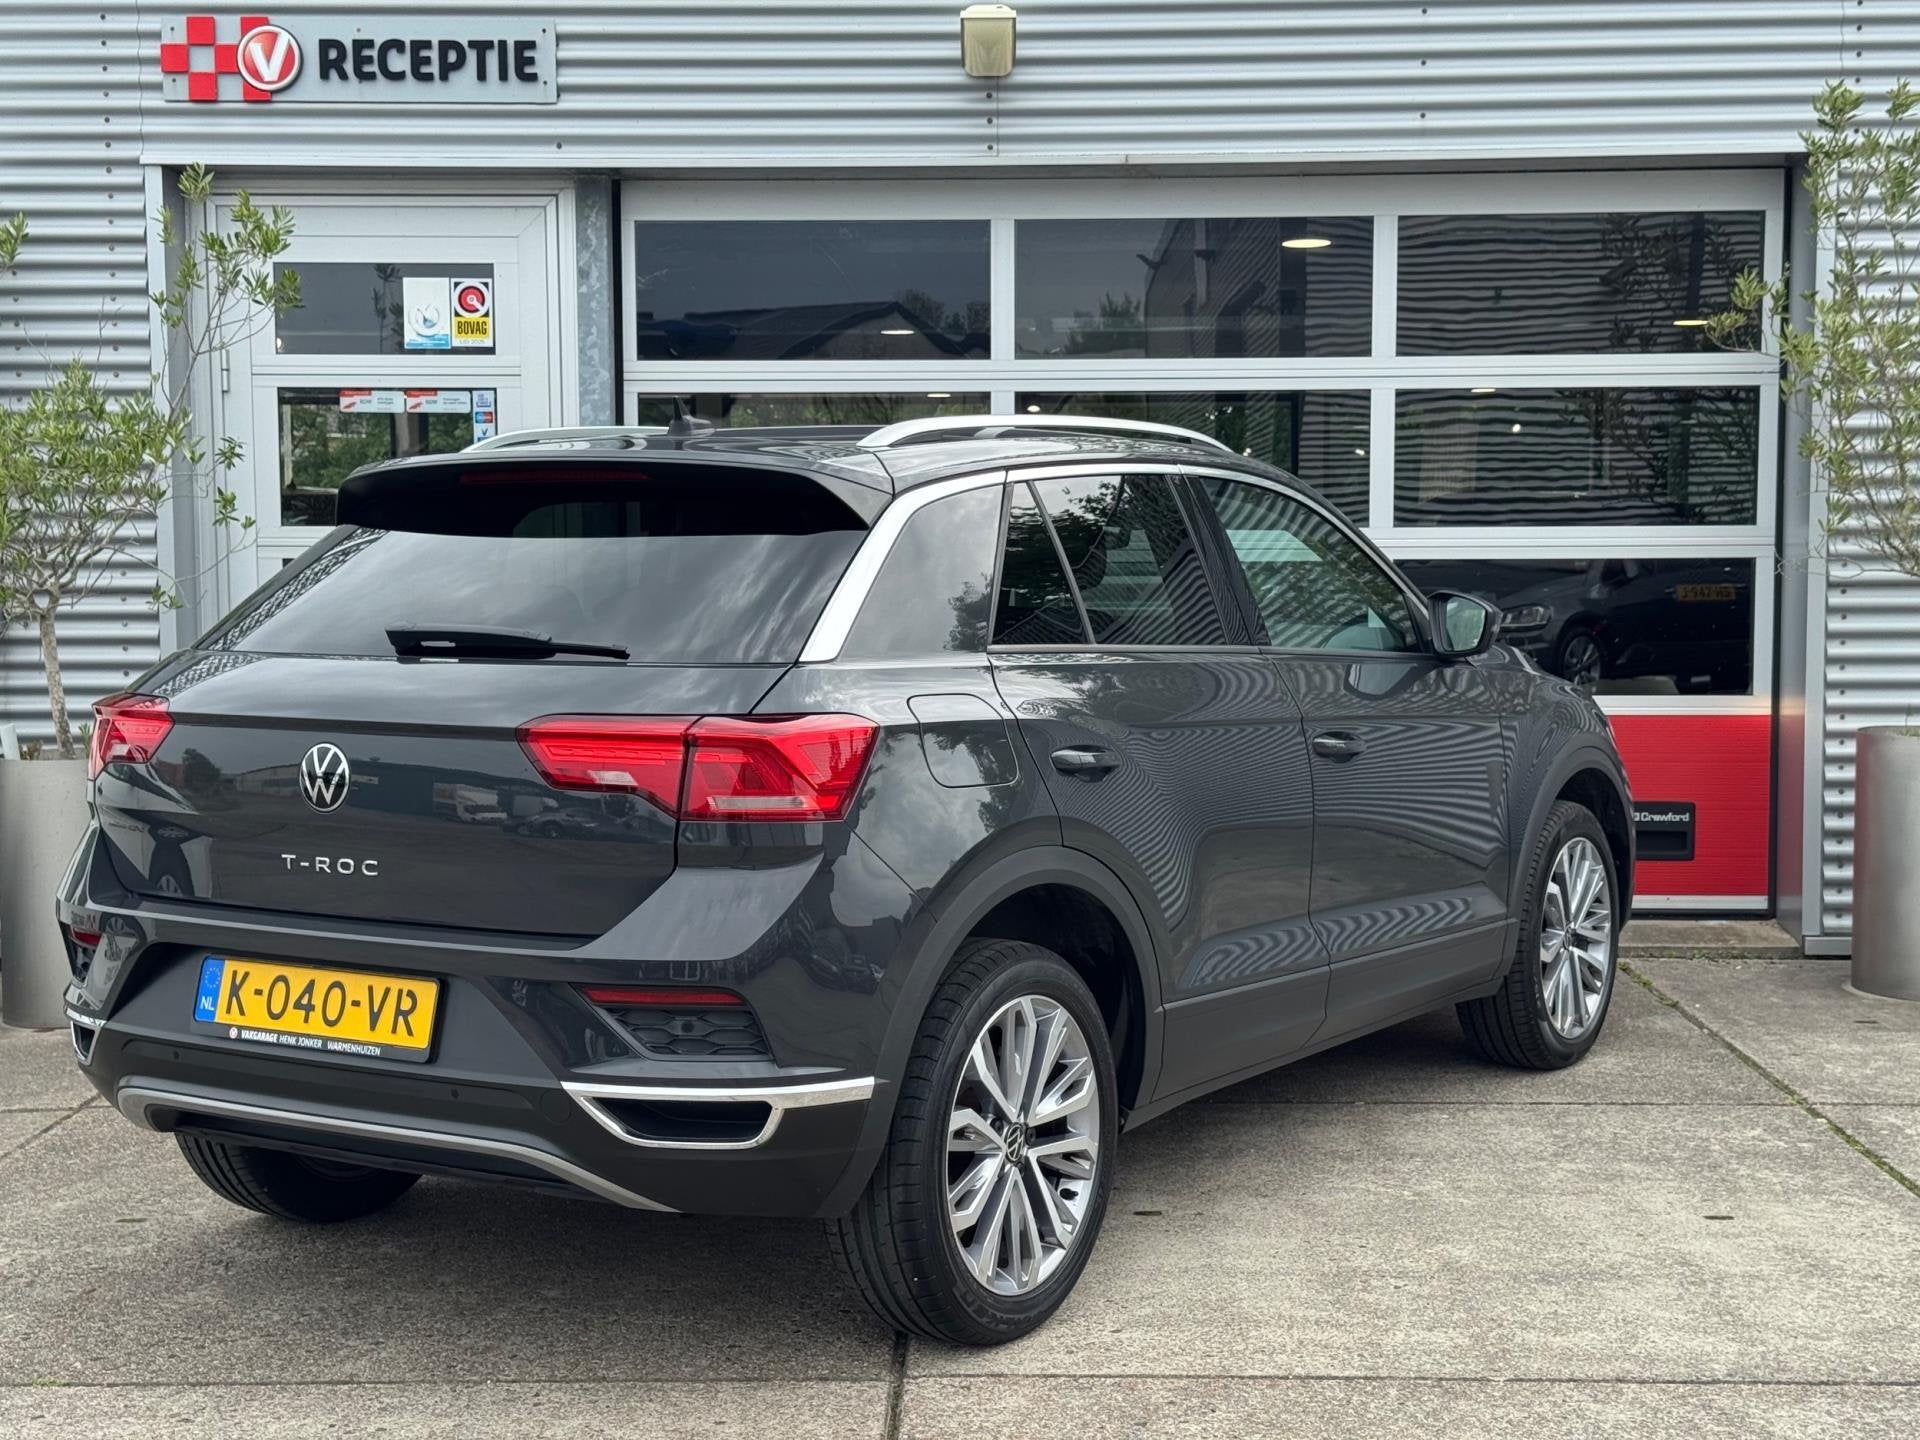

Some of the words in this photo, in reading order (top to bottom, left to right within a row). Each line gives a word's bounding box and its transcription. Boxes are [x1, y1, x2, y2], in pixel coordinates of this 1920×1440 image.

[318, 38, 539, 82] RECEPTIE
[457, 320, 488, 336] BOVAG
[1641, 812, 1690, 822] Crawford
[281, 854, 379, 876] T-ROC
[200, 996, 215, 1011] NL
[225, 969, 418, 1037] K-040-VR
[241, 1029, 278, 1043] VAKGARAGE
[278, 1035, 297, 1046] HENK
[297, 1036, 322, 1048] JONKER
[327, 1040, 381, 1056] WARMENHUIZEN
